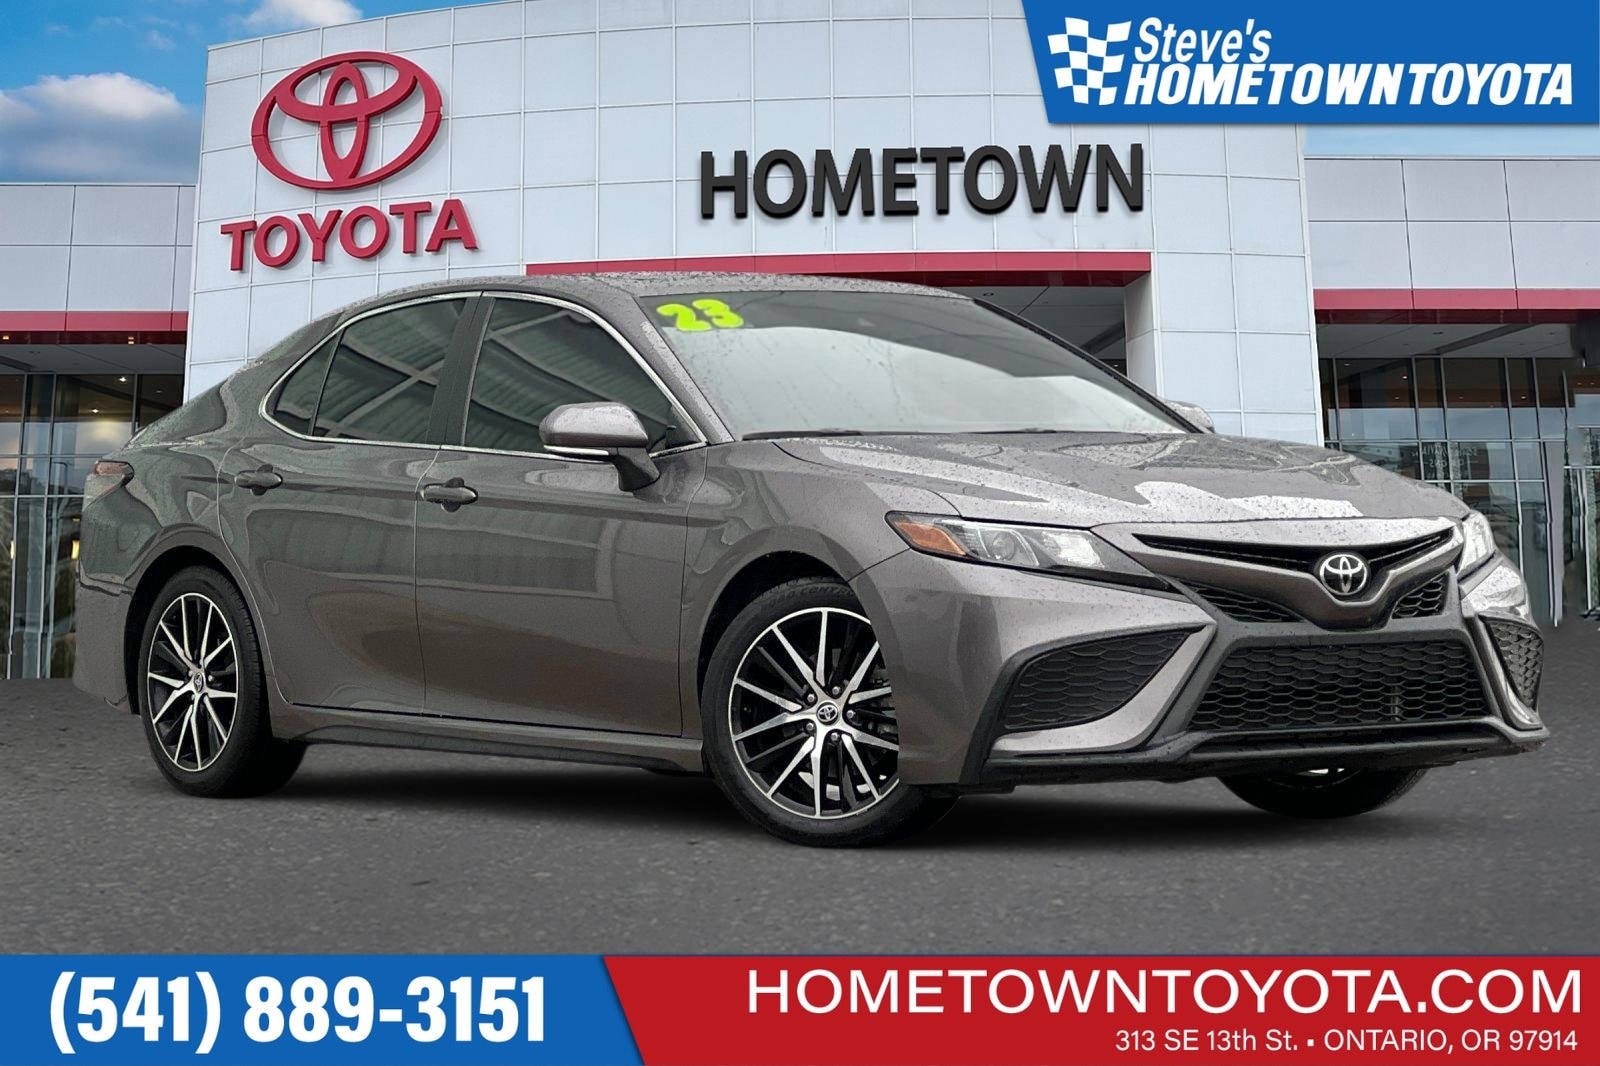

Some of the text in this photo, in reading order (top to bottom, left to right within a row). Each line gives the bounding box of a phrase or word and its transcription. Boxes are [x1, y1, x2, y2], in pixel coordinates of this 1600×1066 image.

[700, 143, 1145, 220] HOMETOWN
[221, 199, 478, 271] TOYOTA
[655, 298, 744, 333] 23
